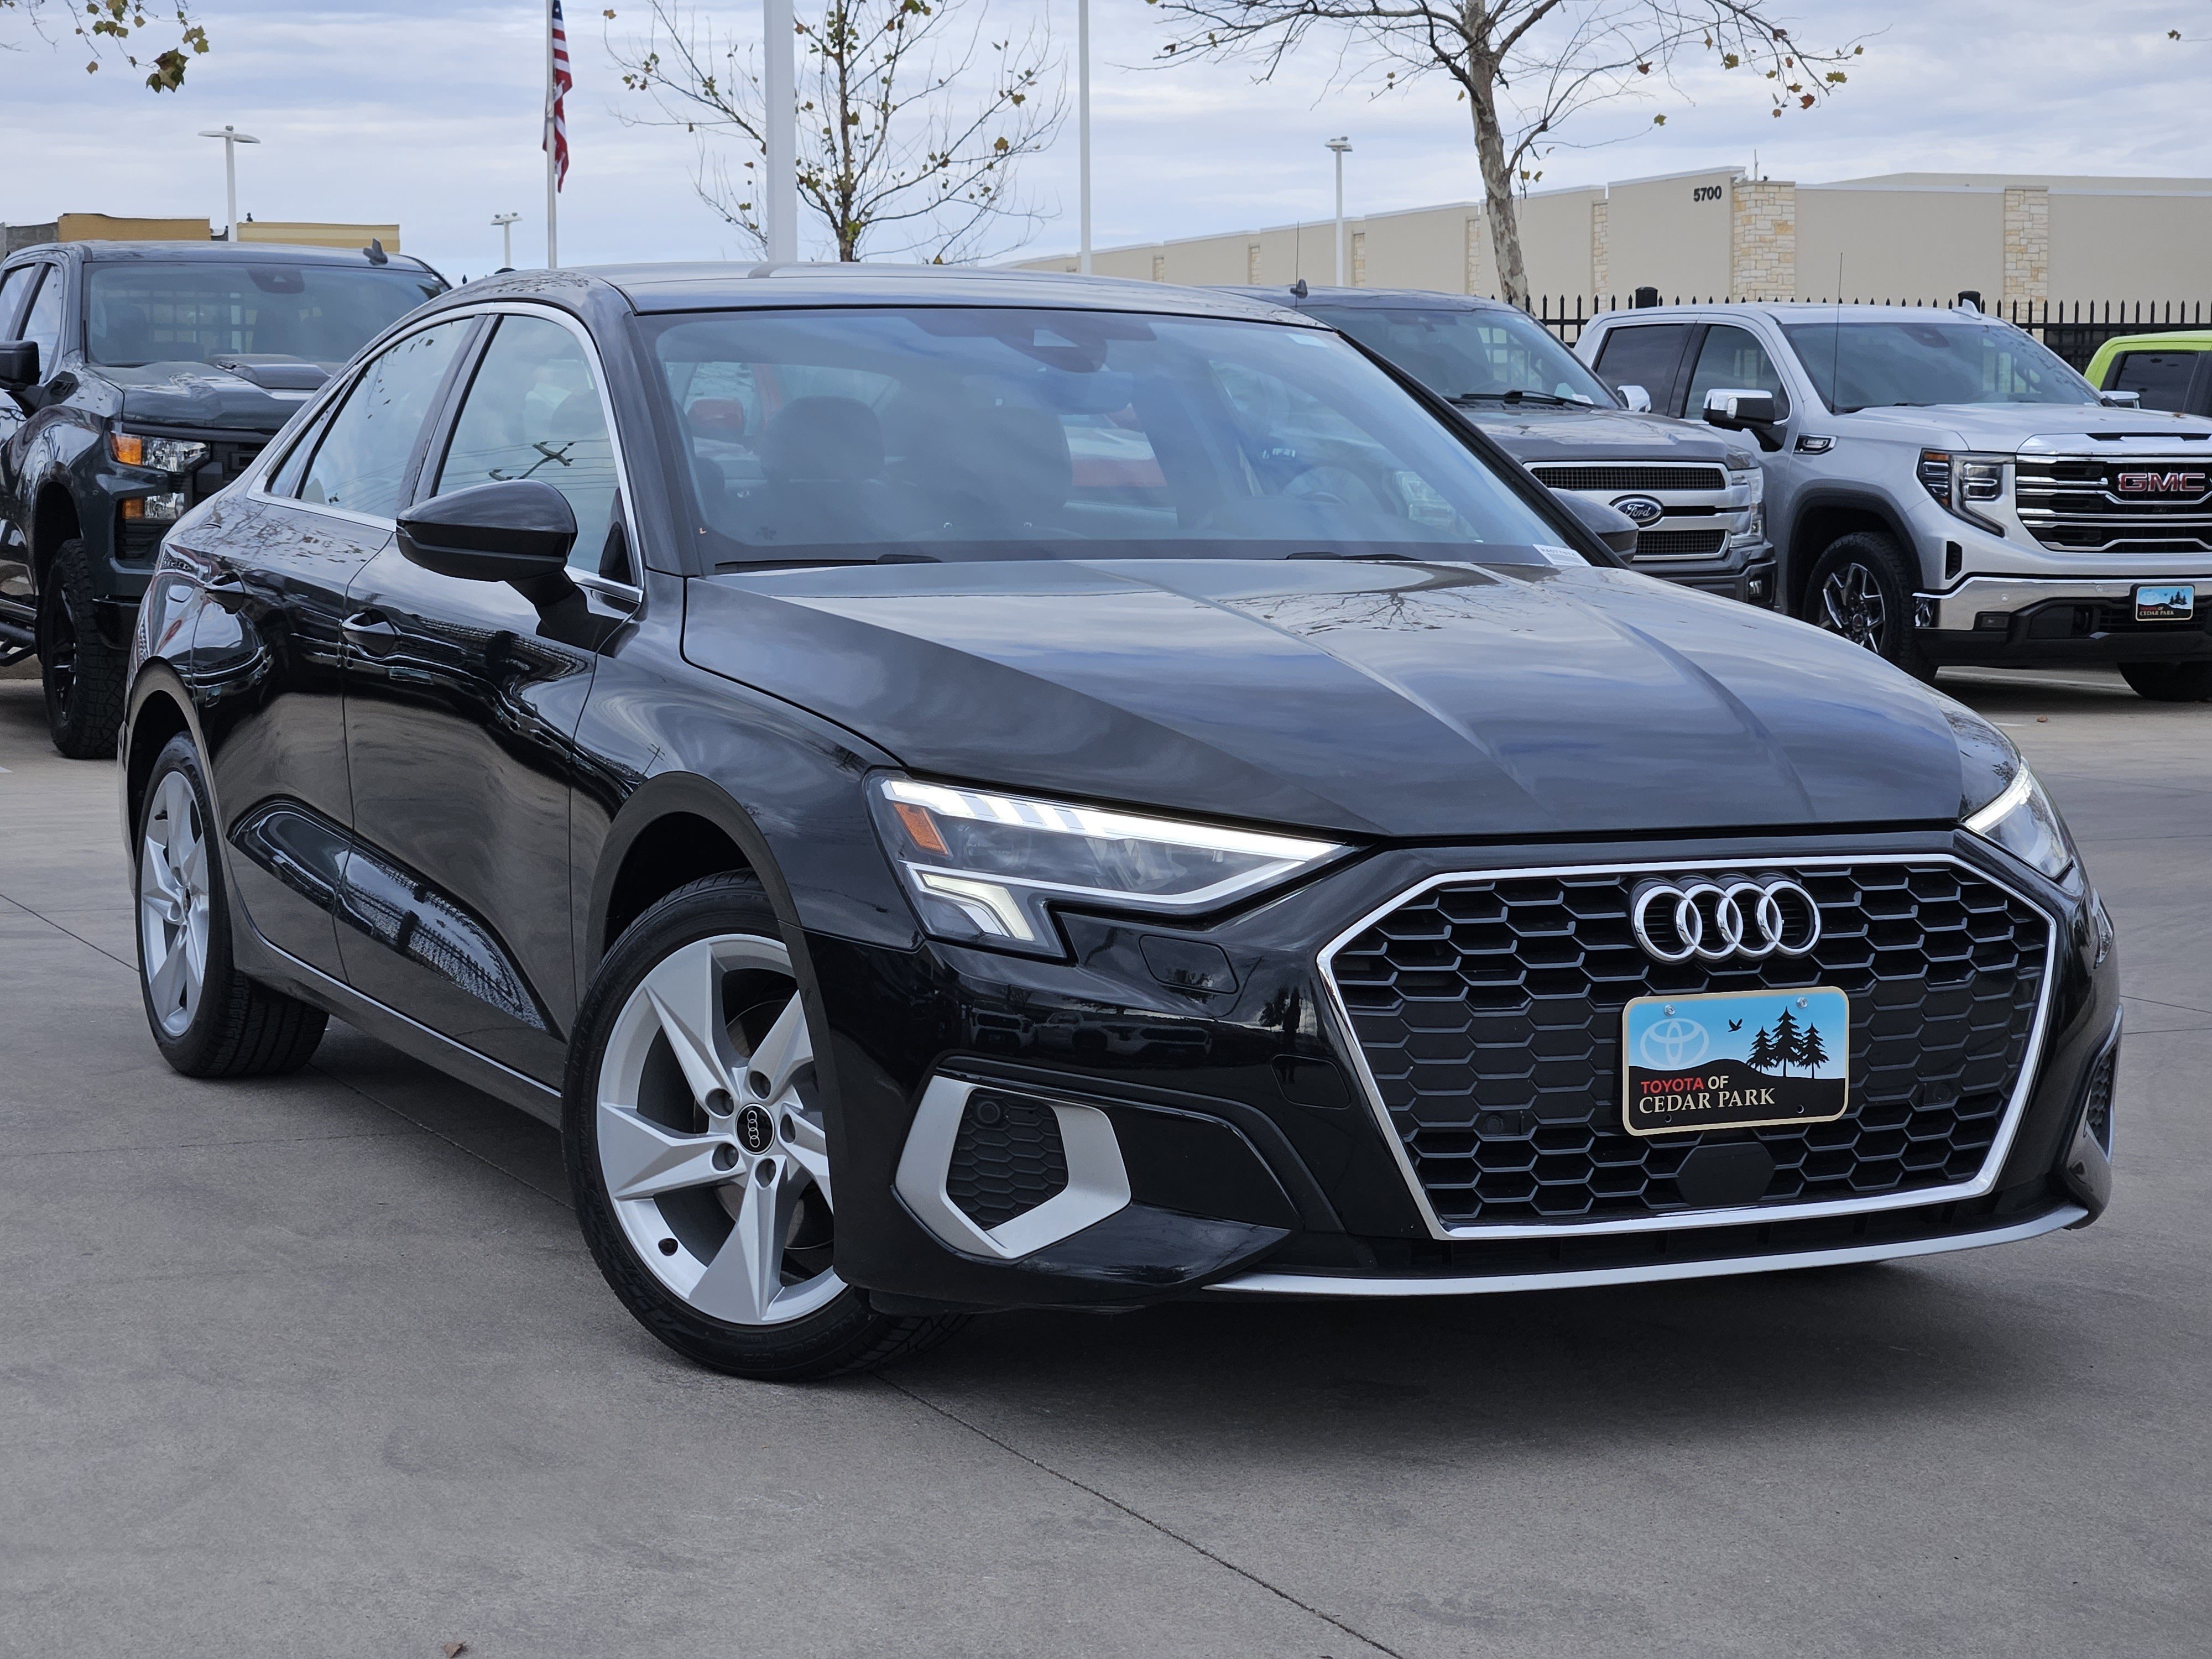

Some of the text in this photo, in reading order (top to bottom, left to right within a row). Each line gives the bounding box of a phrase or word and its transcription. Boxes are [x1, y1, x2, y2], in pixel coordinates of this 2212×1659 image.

[1694, 186, 1722, 202] 5700
[2118, 472, 2205, 492] GMC
[1625, 504, 1651, 517] Ford
[1641, 1076, 1729, 1094] TOYOTA OF
[1639, 1088, 1775, 1114] CEDAR PARK
